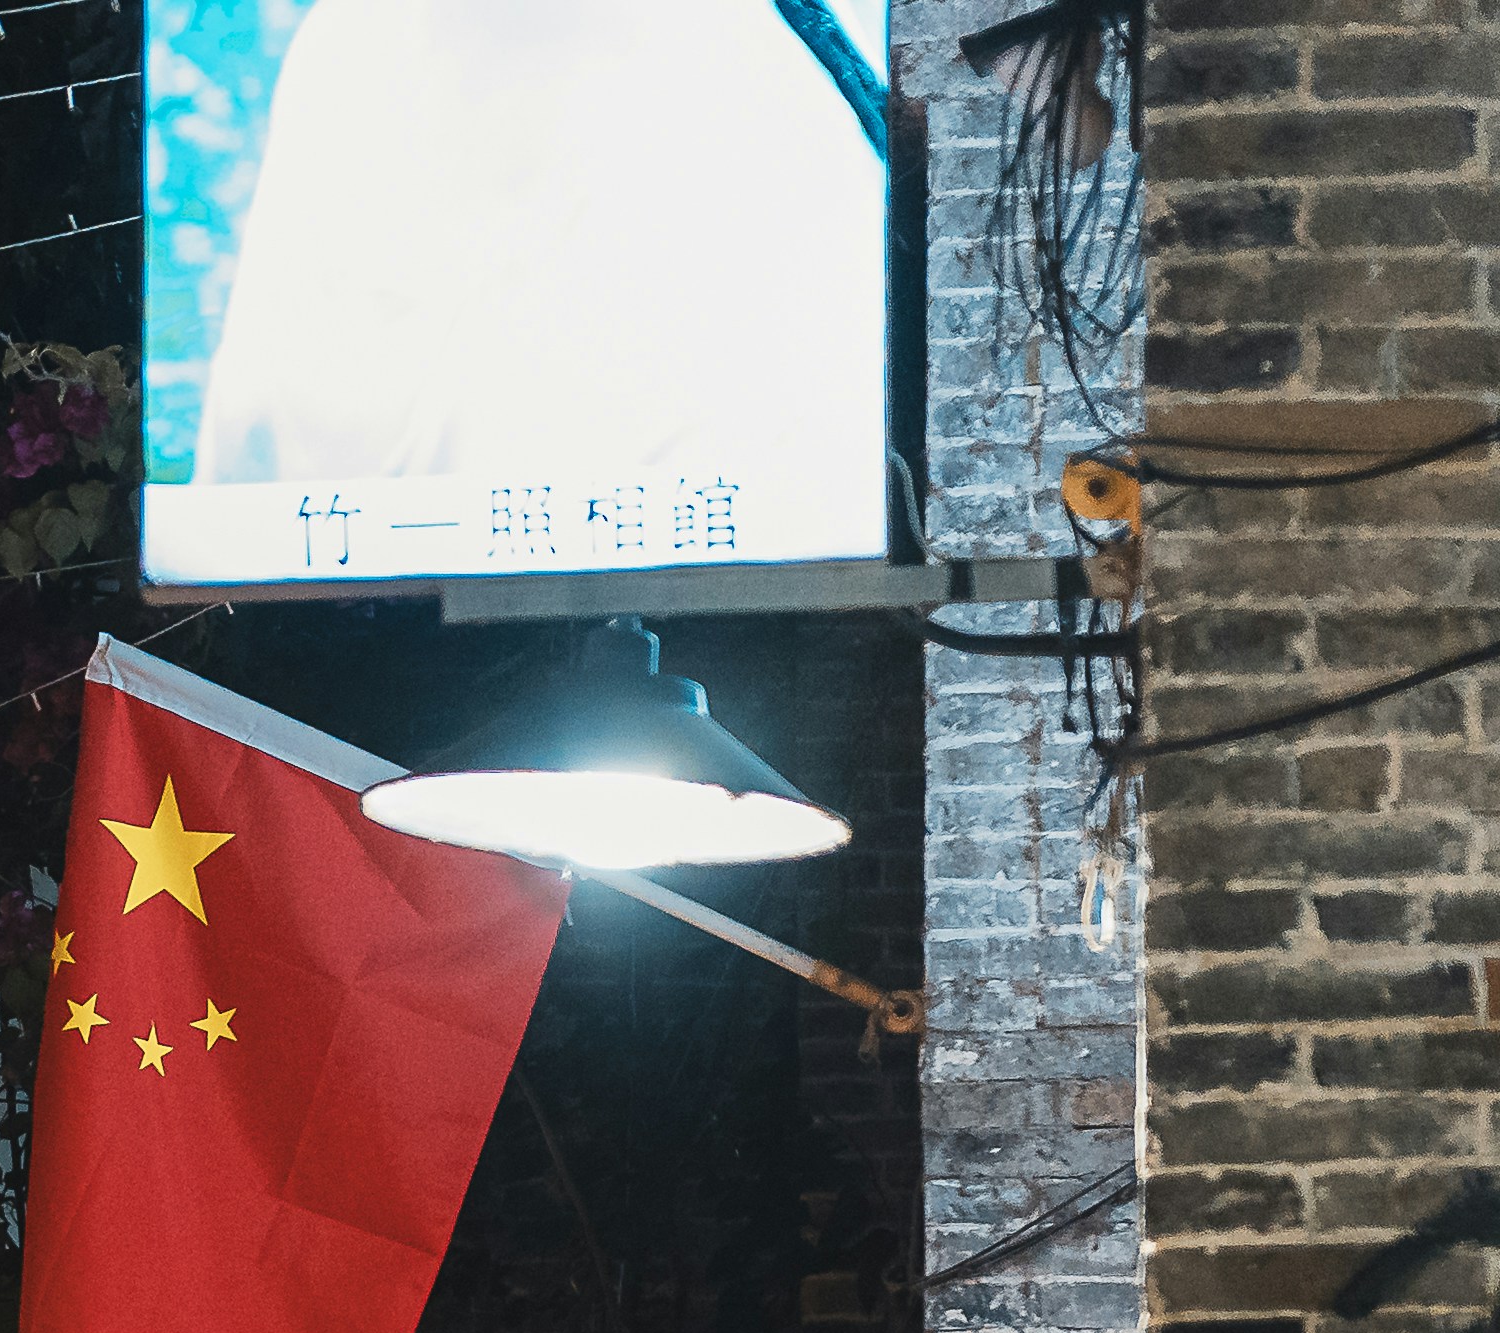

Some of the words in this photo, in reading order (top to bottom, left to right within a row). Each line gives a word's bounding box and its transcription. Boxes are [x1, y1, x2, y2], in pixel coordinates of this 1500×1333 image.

[295, 476, 741, 568] 竹一照相館
